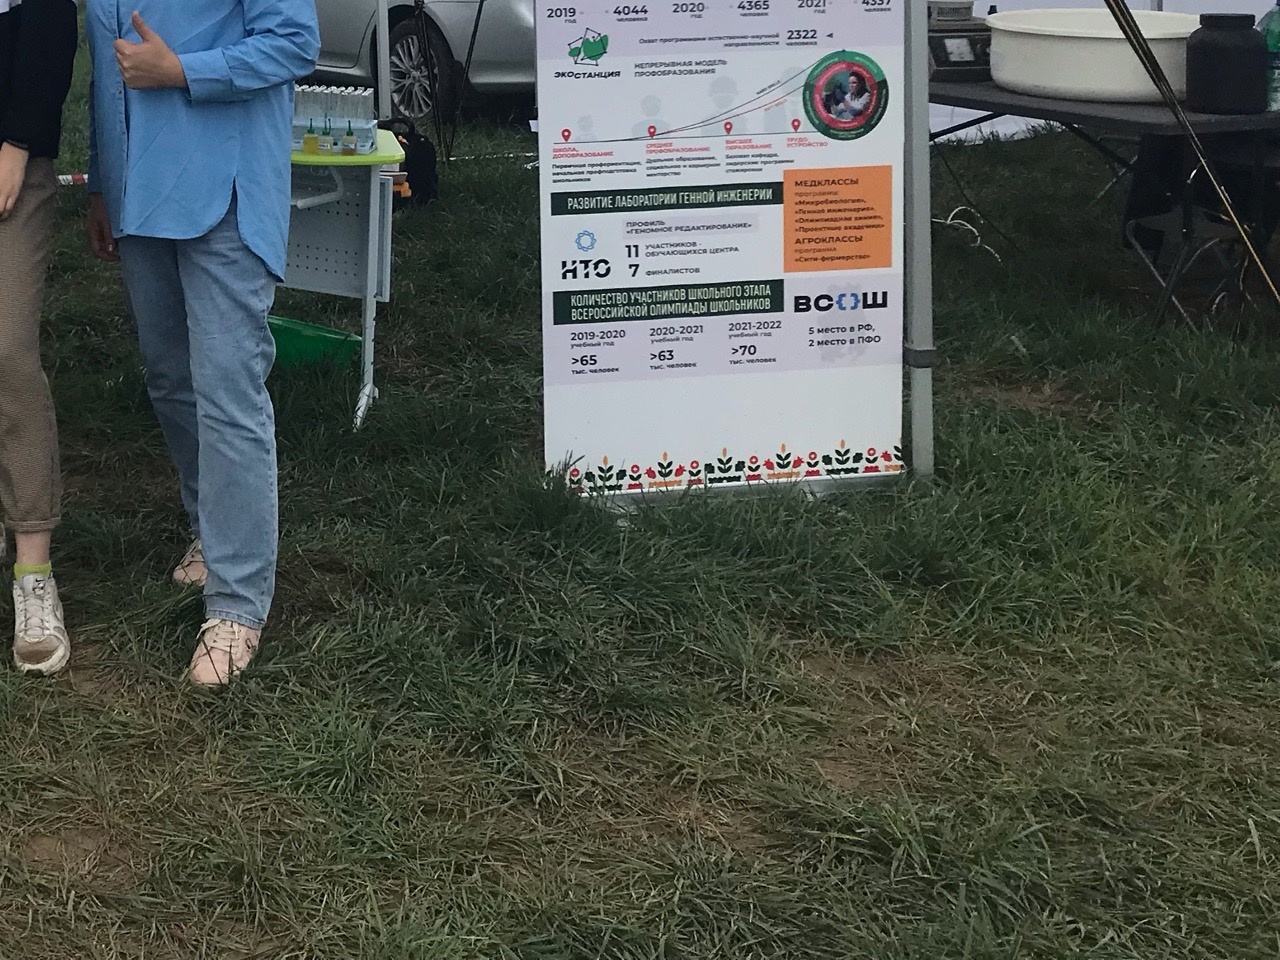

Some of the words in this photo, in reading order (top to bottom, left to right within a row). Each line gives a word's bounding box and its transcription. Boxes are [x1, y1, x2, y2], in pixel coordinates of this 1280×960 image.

[547, 8, 576, 18] 2019
[613, 5, 648, 16] 4044
[672, 3, 705, 13] 2020
[737, 0, 770, 11] 4365
[787, 29, 817, 40] 2322
[634, 60, 693, 69] НЕПРЕРЫВНАЯ
[694, 59, 727, 67] МОДЕЛЬ
[554, 70, 621, 80] ЭКОСТАНЦИЯ
[634, 68, 716, 78] ПРОФОБРАЗОВАНИЯ
[794, 178, 859, 187] МЕДКЛАССЫ
[567, 195, 613, 210] РАЗВИТИЕ
[614, 192, 677, 208] ЛАБОРАТОРИИ
[678, 189, 715, 204] ГЕННОЙ
[716, 188, 773, 203] ИНЖЕНЕРИИ
[626, 219, 665, 228] ПРОФИЛЬ
[794, 235, 863, 245] АГРОКЛАССЫ
[625, 244, 640, 258] 11
[645, 241, 698, 250] УЧАСТНИКОВ
[645, 249, 708, 258] ОБУЧАЮЩИХСЯ
[709, 246, 739, 255] ЦЕНТРА
[561, 258, 611, 280] НТО
[628, 264, 640, 277] 7
[645, 267, 700, 276] ФИНАЛИСТОВ
[571, 292, 628, 307] КОЛИЧЕСТВО
[630, 289, 686, 303] УЧАСТНИКОВ
[688, 286, 742, 300] ШКОЛЬНОГО
[744, 284, 771, 297] ЭТАПА
[571, 305, 648, 321] ВСЕРОССИЙСКОЙ
[649, 302, 707, 316] ОЛИМПИАДЫ
[709, 298, 771, 313] ШКОЛЬНИКОВ
[570, 330, 626, 340] 2019-2020
[649, 325, 704, 337] 2020-2021
[728, 320, 782, 332] 2021-2022
[808, 327, 814, 335] 5
[817, 326, 847, 334] место
[857, 323, 876, 332] РФ,
[808, 339, 814, 347] 2
[857, 335, 881, 344] ПФО
[571, 355, 597, 366] >65
[650, 350, 675, 361] >63
[731, 345, 757, 356] >70
